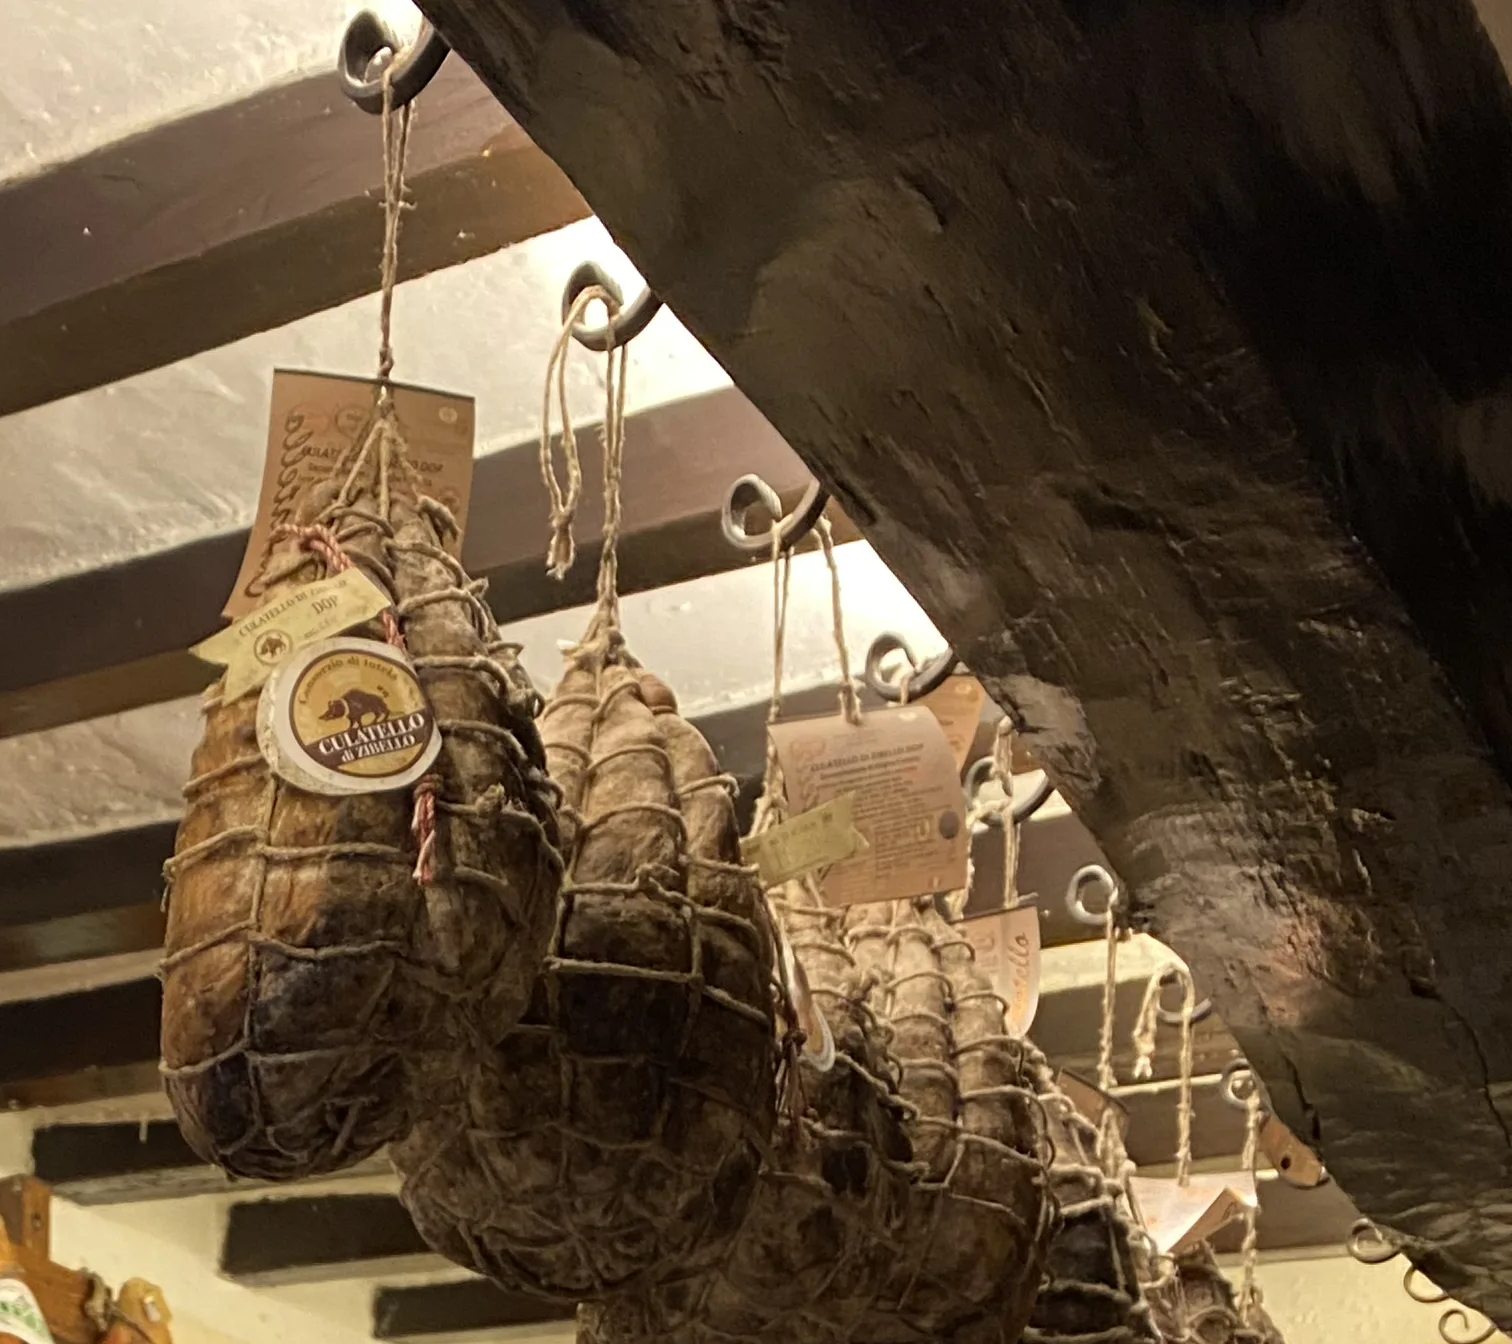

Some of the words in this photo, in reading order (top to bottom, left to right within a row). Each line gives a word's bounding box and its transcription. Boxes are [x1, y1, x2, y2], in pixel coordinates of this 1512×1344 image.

[347, 655, 360, 667] di
[318, 712, 425, 755] CULATELLO
[341, 749, 355, 763] di
[357, 734, 416, 759] ZIBELLO
